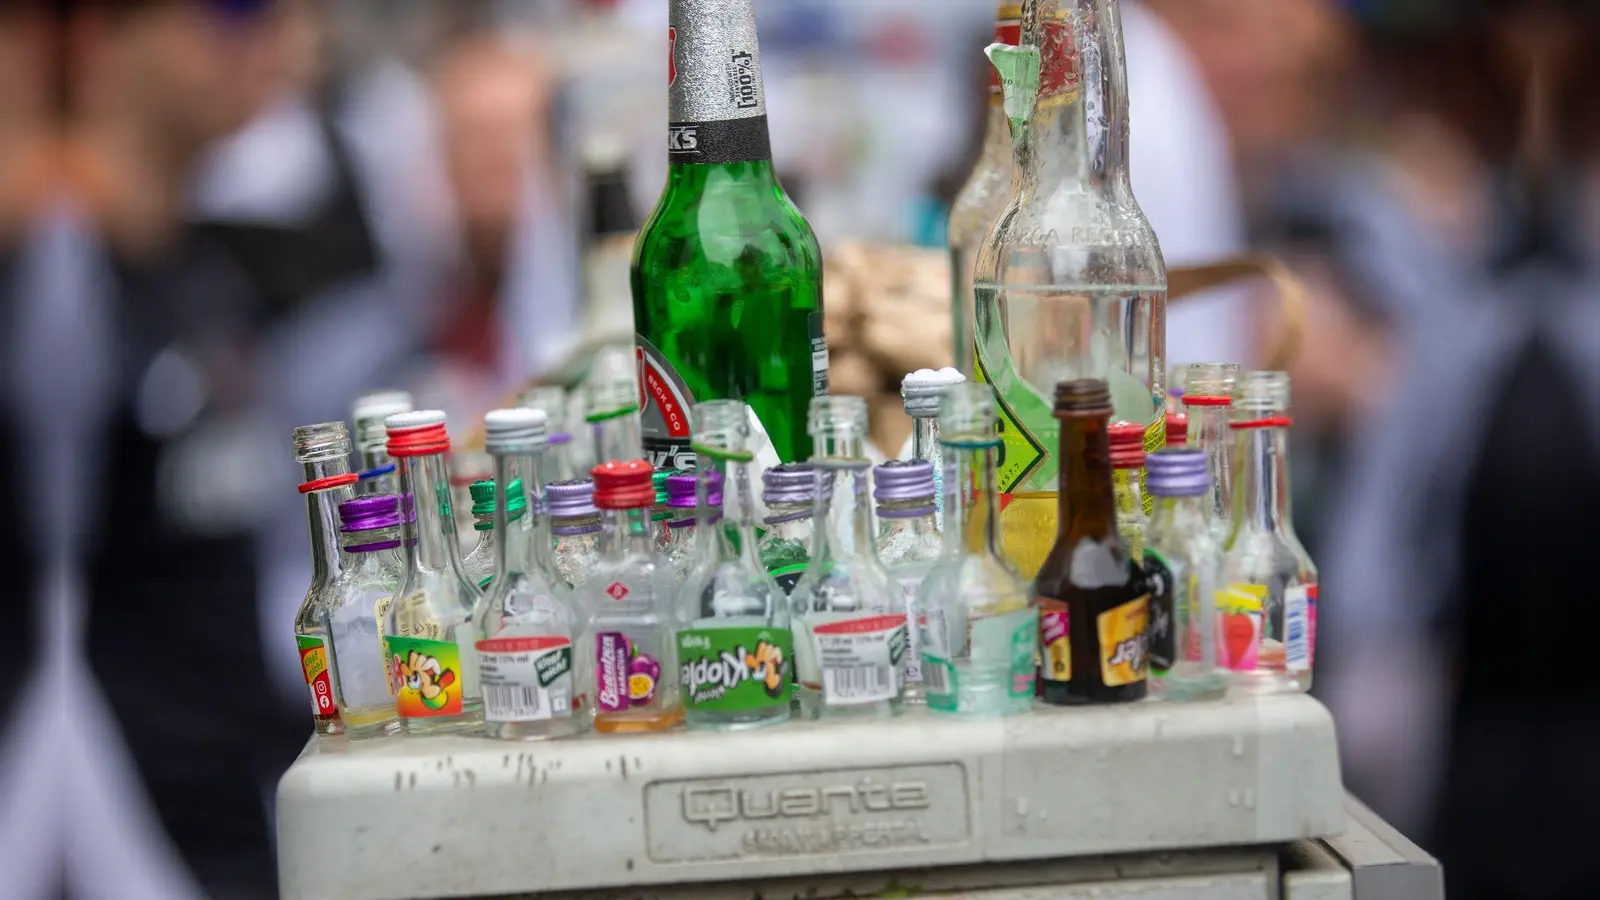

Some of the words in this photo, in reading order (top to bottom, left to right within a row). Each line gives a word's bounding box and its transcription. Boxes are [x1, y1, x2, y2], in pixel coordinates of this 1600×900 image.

[648, 374, 667, 403] BECK
[669, 412, 681, 431] CO
[599, 636, 620, 709] Berentzen
[616, 647, 627, 695] MARACUJA
[680, 646, 749, 696] Klopfe
[681, 780, 931, 834] Quante
